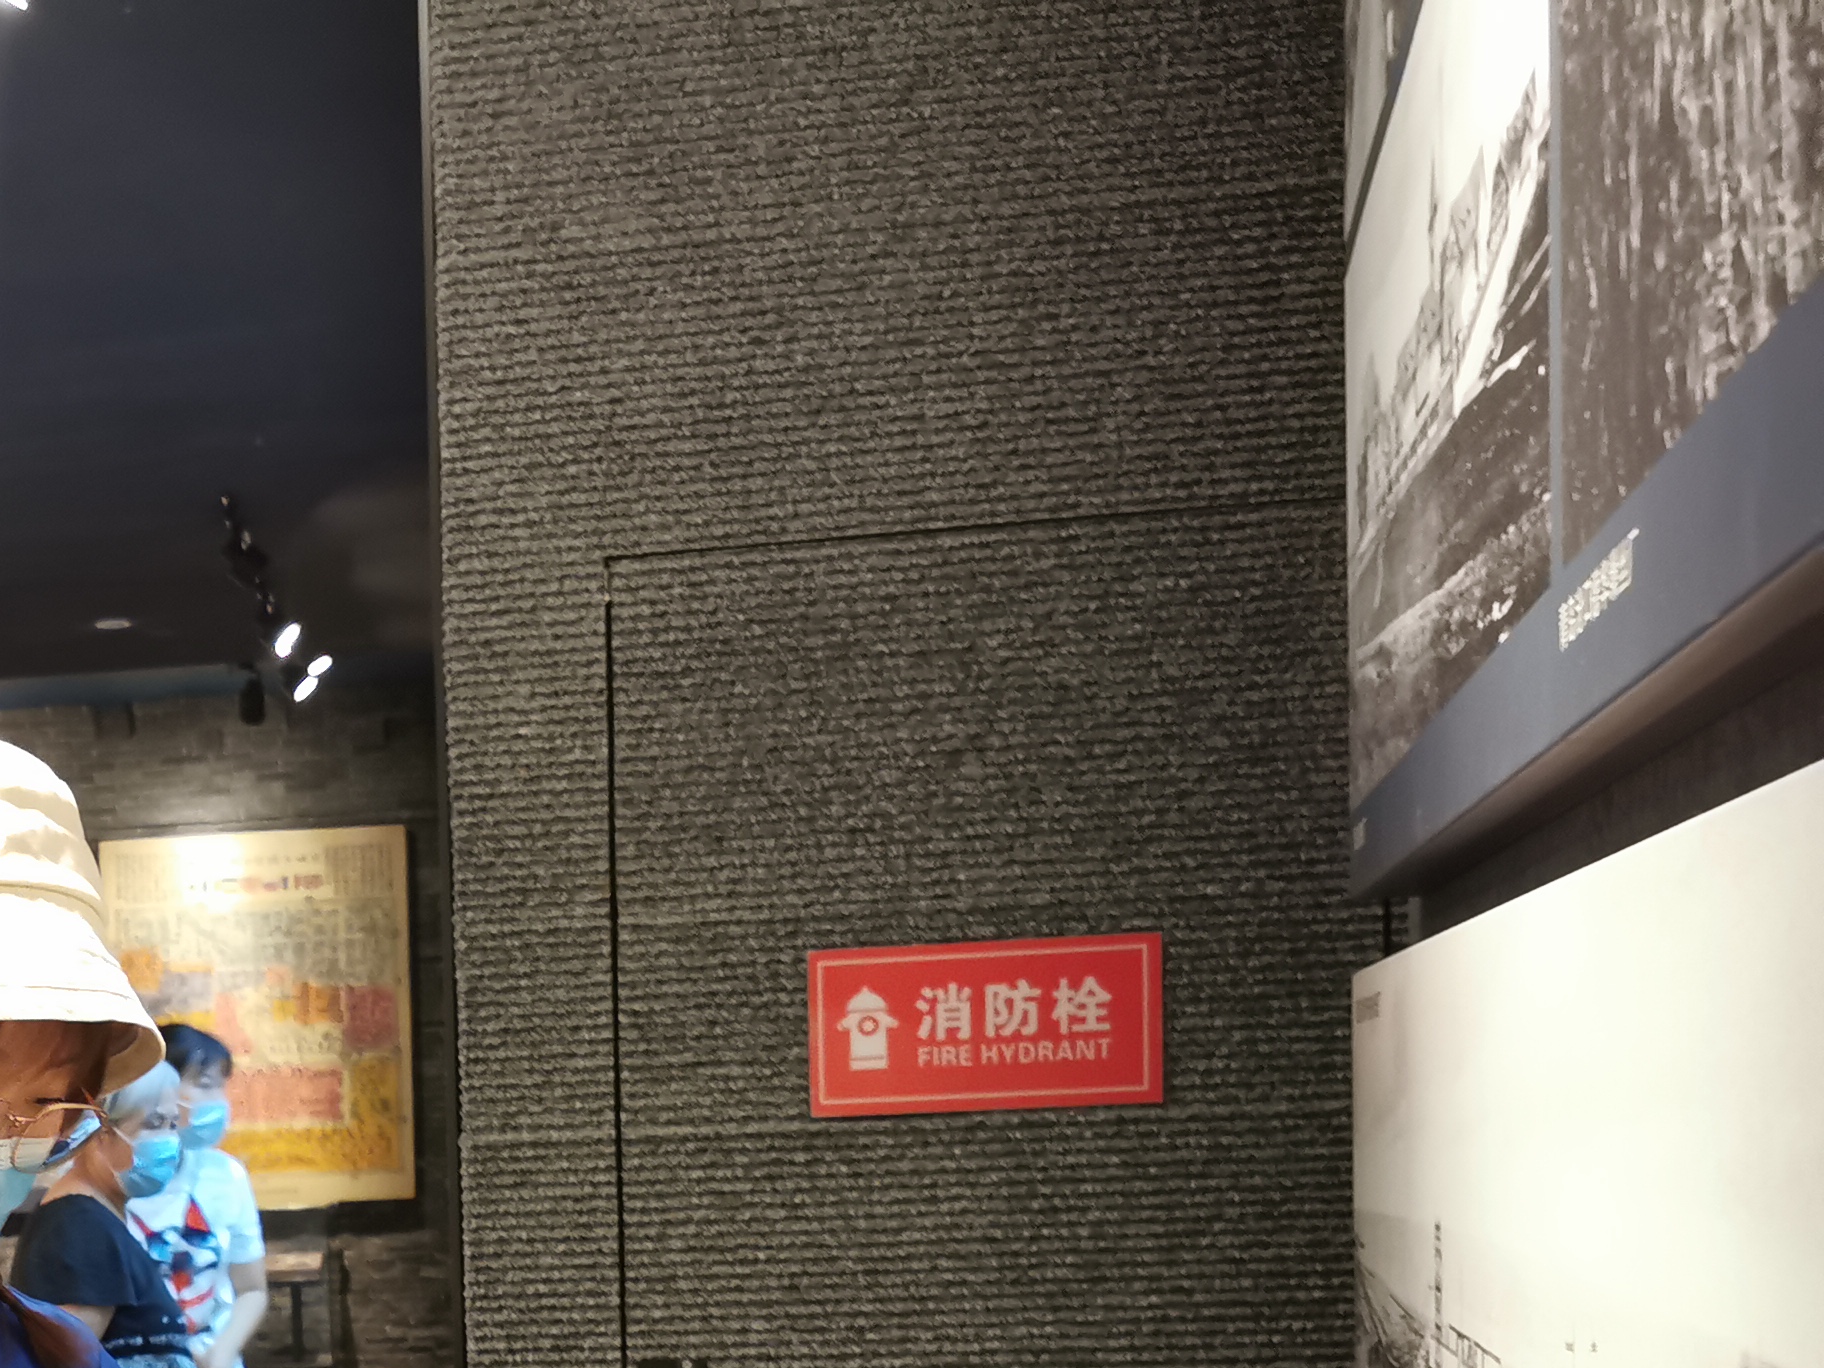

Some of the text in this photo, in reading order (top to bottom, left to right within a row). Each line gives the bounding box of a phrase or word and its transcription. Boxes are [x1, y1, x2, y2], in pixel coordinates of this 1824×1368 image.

[915, 975, 1113, 1041] 消防栓
[916, 1037, 1113, 1068] FIRE HYDRANT
